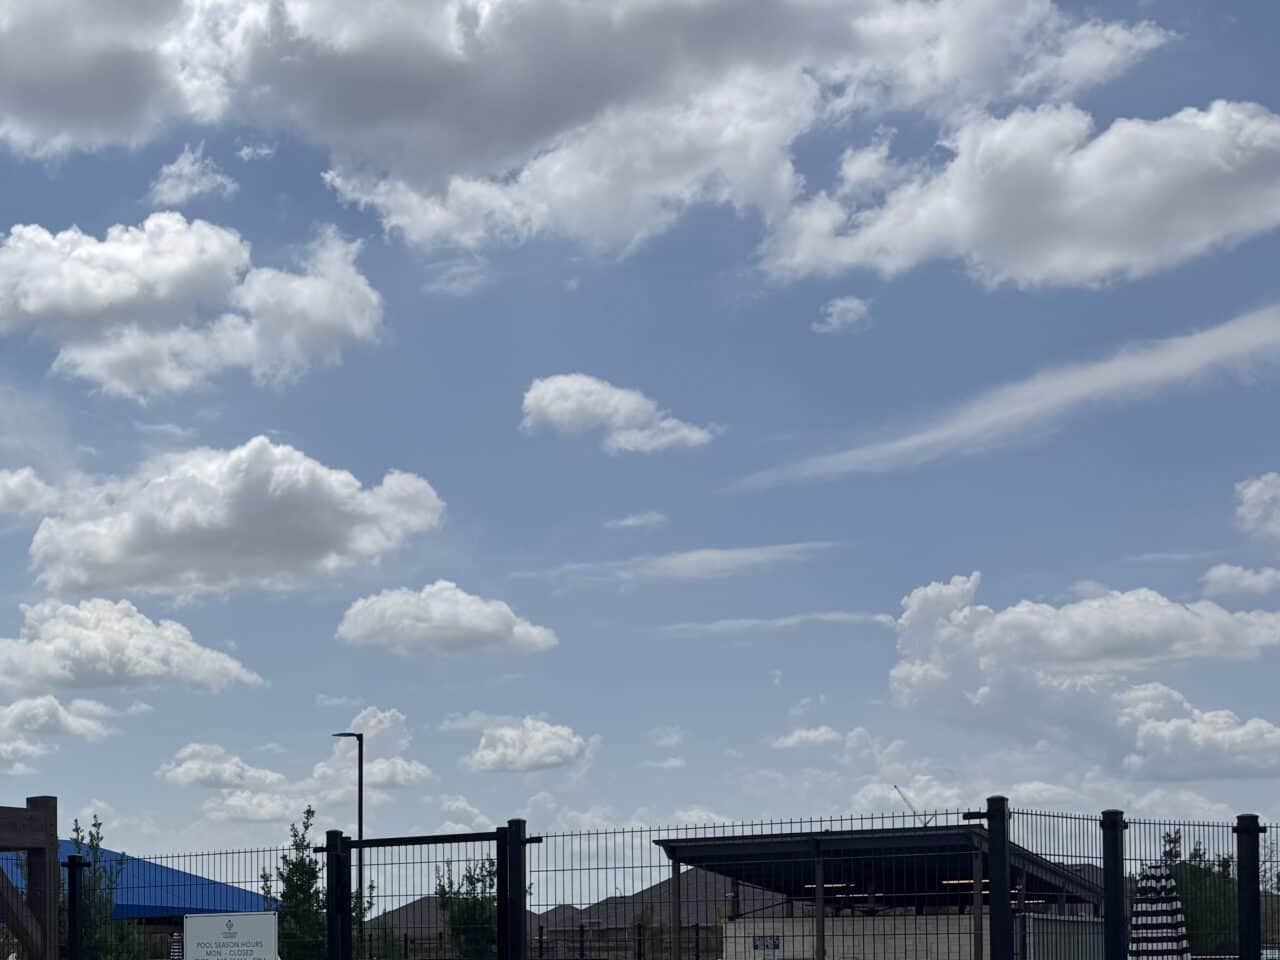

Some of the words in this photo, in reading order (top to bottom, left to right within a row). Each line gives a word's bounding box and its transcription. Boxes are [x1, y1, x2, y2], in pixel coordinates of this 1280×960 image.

[214, 941, 240, 949] SEASON
[241, 940, 263, 948] HOURS
[229, 949, 254, 957] CLOSED
